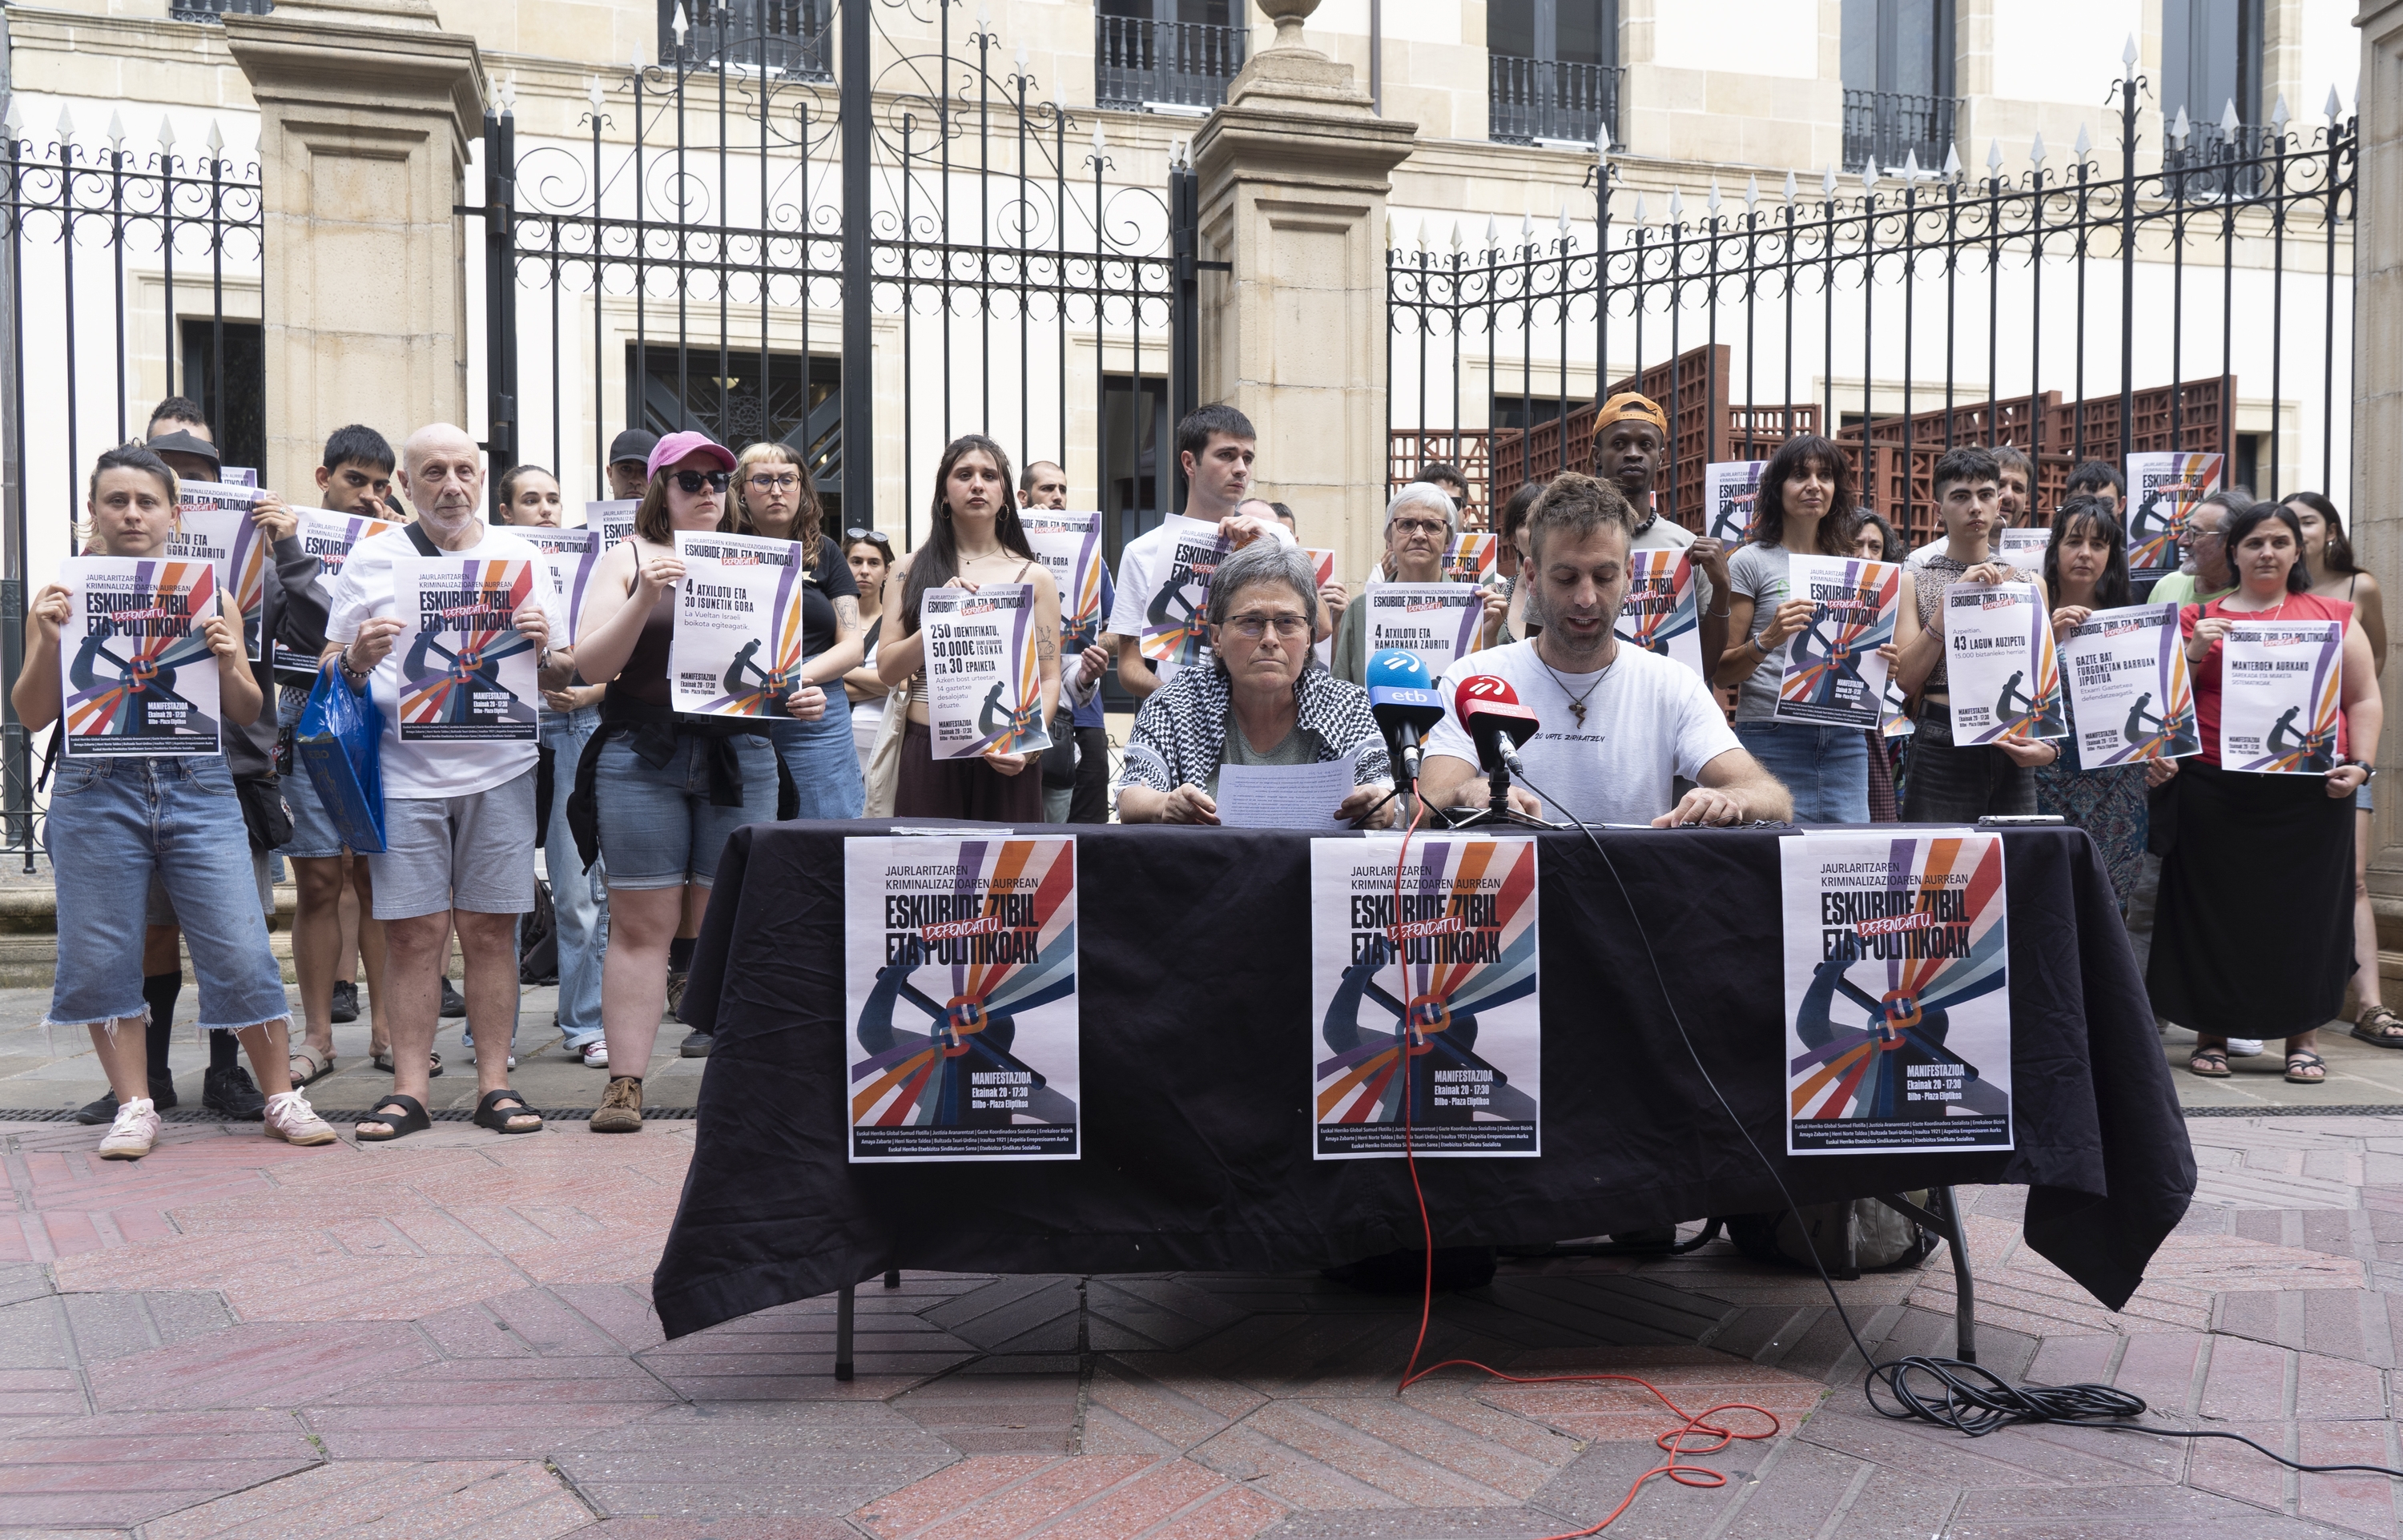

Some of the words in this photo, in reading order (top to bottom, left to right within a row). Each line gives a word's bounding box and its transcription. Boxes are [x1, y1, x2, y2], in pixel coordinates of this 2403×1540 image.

[194, 534, 207, 546] ETA
[191, 547, 225, 559] ZAURITU
[685, 545, 720, 558] ESKUBIDE
[755, 551, 793, 567] POLITIKOAK
[723, 557, 758, 565] DEFENDATU
[86, 573, 143, 583] JAURLARITZAREN
[87, 582, 158, 591] KRIMINALIZAZIOAREN
[686, 579, 693, 594] 4
[697, 585, 731, 598] ATXILOTU
[735, 588, 747, 600] ETA
[420, 591, 480, 611] ESKUBIDE
[482, 590, 513, 610] ZIBIL
[1810, 583, 1857, 601] ESKUBIDE
[1859, 589, 1881, 609] ZIBIL
[87, 592, 154, 615] ESKUBIDE
[157, 594, 191, 616] ZIBIL
[445, 604, 489, 617] DEFENDATU
[686, 597, 695, 608] 30
[698, 597, 732, 610] ISUNETIK
[735, 601, 754, 612] GORA
[1829, 600, 1863, 608] DEFENDATU
[115, 607, 164, 622] DEFENDATU
[1826, 608, 1880, 627] POLITIKOAK
[87, 615, 111, 637] ETA
[114, 616, 191, 639] POLITIKOAK
[421, 613, 442, 632] ETA
[444, 612, 513, 632] POLITIKOAK
[685, 619, 710, 627] boikota
[712, 621, 750, 630] egiteagatik.
[931, 624, 951, 639] 250
[954, 625, 999, 637] IDENTIFIKATU,
[1375, 625, 1382, 638] 4
[1385, 629, 1416, 638] ATXILOTU
[1419, 629, 1431, 638] ETA
[932, 641, 975, 657] 50.000€
[976, 645, 1003, 655] ISUNAK
[1375, 640, 1418, 649] HAMARNAKA
[1421, 640, 1449, 649] ZAURITU
[1954, 636, 1966, 650] 43
[1970, 638, 1992, 649] LAGUN
[1995, 636, 2025, 648] AUZIPETU
[1976, 649, 2005, 657] biztanleko
[2076, 654, 2097, 666] GAZTE
[2099, 652, 2112, 663] BAT
[935, 663, 947, 674] ETA
[949, 658, 963, 673] 30
[966, 661, 996, 673] EPAIKETA
[2077, 661, 2121, 677] FURGONETAN
[2123, 657, 2155, 669] BARRUAN
[2232, 661, 2273, 670] MANTEROEN
[2276, 661, 2308, 671] AURKAKO
[2079, 673, 2111, 686] JIPOITUA
[946, 685, 972, 693] gaztetxe
[2102, 683, 2133, 691] Gaztetxea
[1391, 690, 1427, 702] etb
[2082, 690, 2135, 702] defendatzeagatik.
[148, 702, 188, 710] MANIFESTAZIOA
[1483, 702, 1522, 711] euskadi
[1483, 706, 1517, 715] irratia
[885, 865, 968, 876] JAURLARITZAREN
[1820, 862, 1900, 874] JAURLARITZAREN
[886, 879, 990, 890] KRIMINALIZAZIOAREN
[992, 878, 1038, 888] AURREAN
[1455, 879, 1501, 889] AURREAN
[1821, 875, 1921, 887] KRIMINALIZAZIOAREN
[1924, 875, 1968, 885] AURREAN
[886, 895, 984, 929] ESKUBIDE
[988, 894, 1039, 927] ZIBIL
[1451, 894, 1501, 927] ZIBIL
[1821, 891, 1916, 925] ESKUBIDE
[1921, 889, 1970, 923] ZIBIL
[926, 918, 998, 940] DEFENDATU
[1860, 913, 1930, 935] DEFENDATU
[886, 932, 921, 966] ETA
[924, 931, 1039, 966] POLITIKOAK
[1352, 932, 1386, 965] ETA
[1823, 928, 1857, 961] ETA
[1859, 926, 1970, 961] POLITIKOAK
[1435, 1070, 1493, 1083] MANIFESTAZIOA
[1907, 1064, 1965, 1077] MANIFESTAZIOA
[972, 1072, 1032, 1084] MANIFESTAZIOA
[1907, 1080, 1932, 1090] Ekainak
[1933, 1080, 1942, 1089] 20
[1946, 1079, 1962, 1089] 17:30
[972, 1088, 998, 1098] Ekainak
[999, 1088, 1008, 1097] 20
[1012, 1087, 1028, 1097] 17:30
[1435, 1085, 1459, 1096] Ekainak
[1461, 1085, 1469, 1095] 20
[1474, 1084, 1489, 1095] 17:30
[1907, 1092, 1921, 1101] Bilbo
[1924, 1092, 1938, 1100] Plaza
[1939, 1092, 1962, 1102] Eliptikoa
[972, 1100, 986, 1108] Bilbo
[990, 1100, 1004, 1108] Plaza
[1005, 1100, 1028, 1110] Eliptikoa
